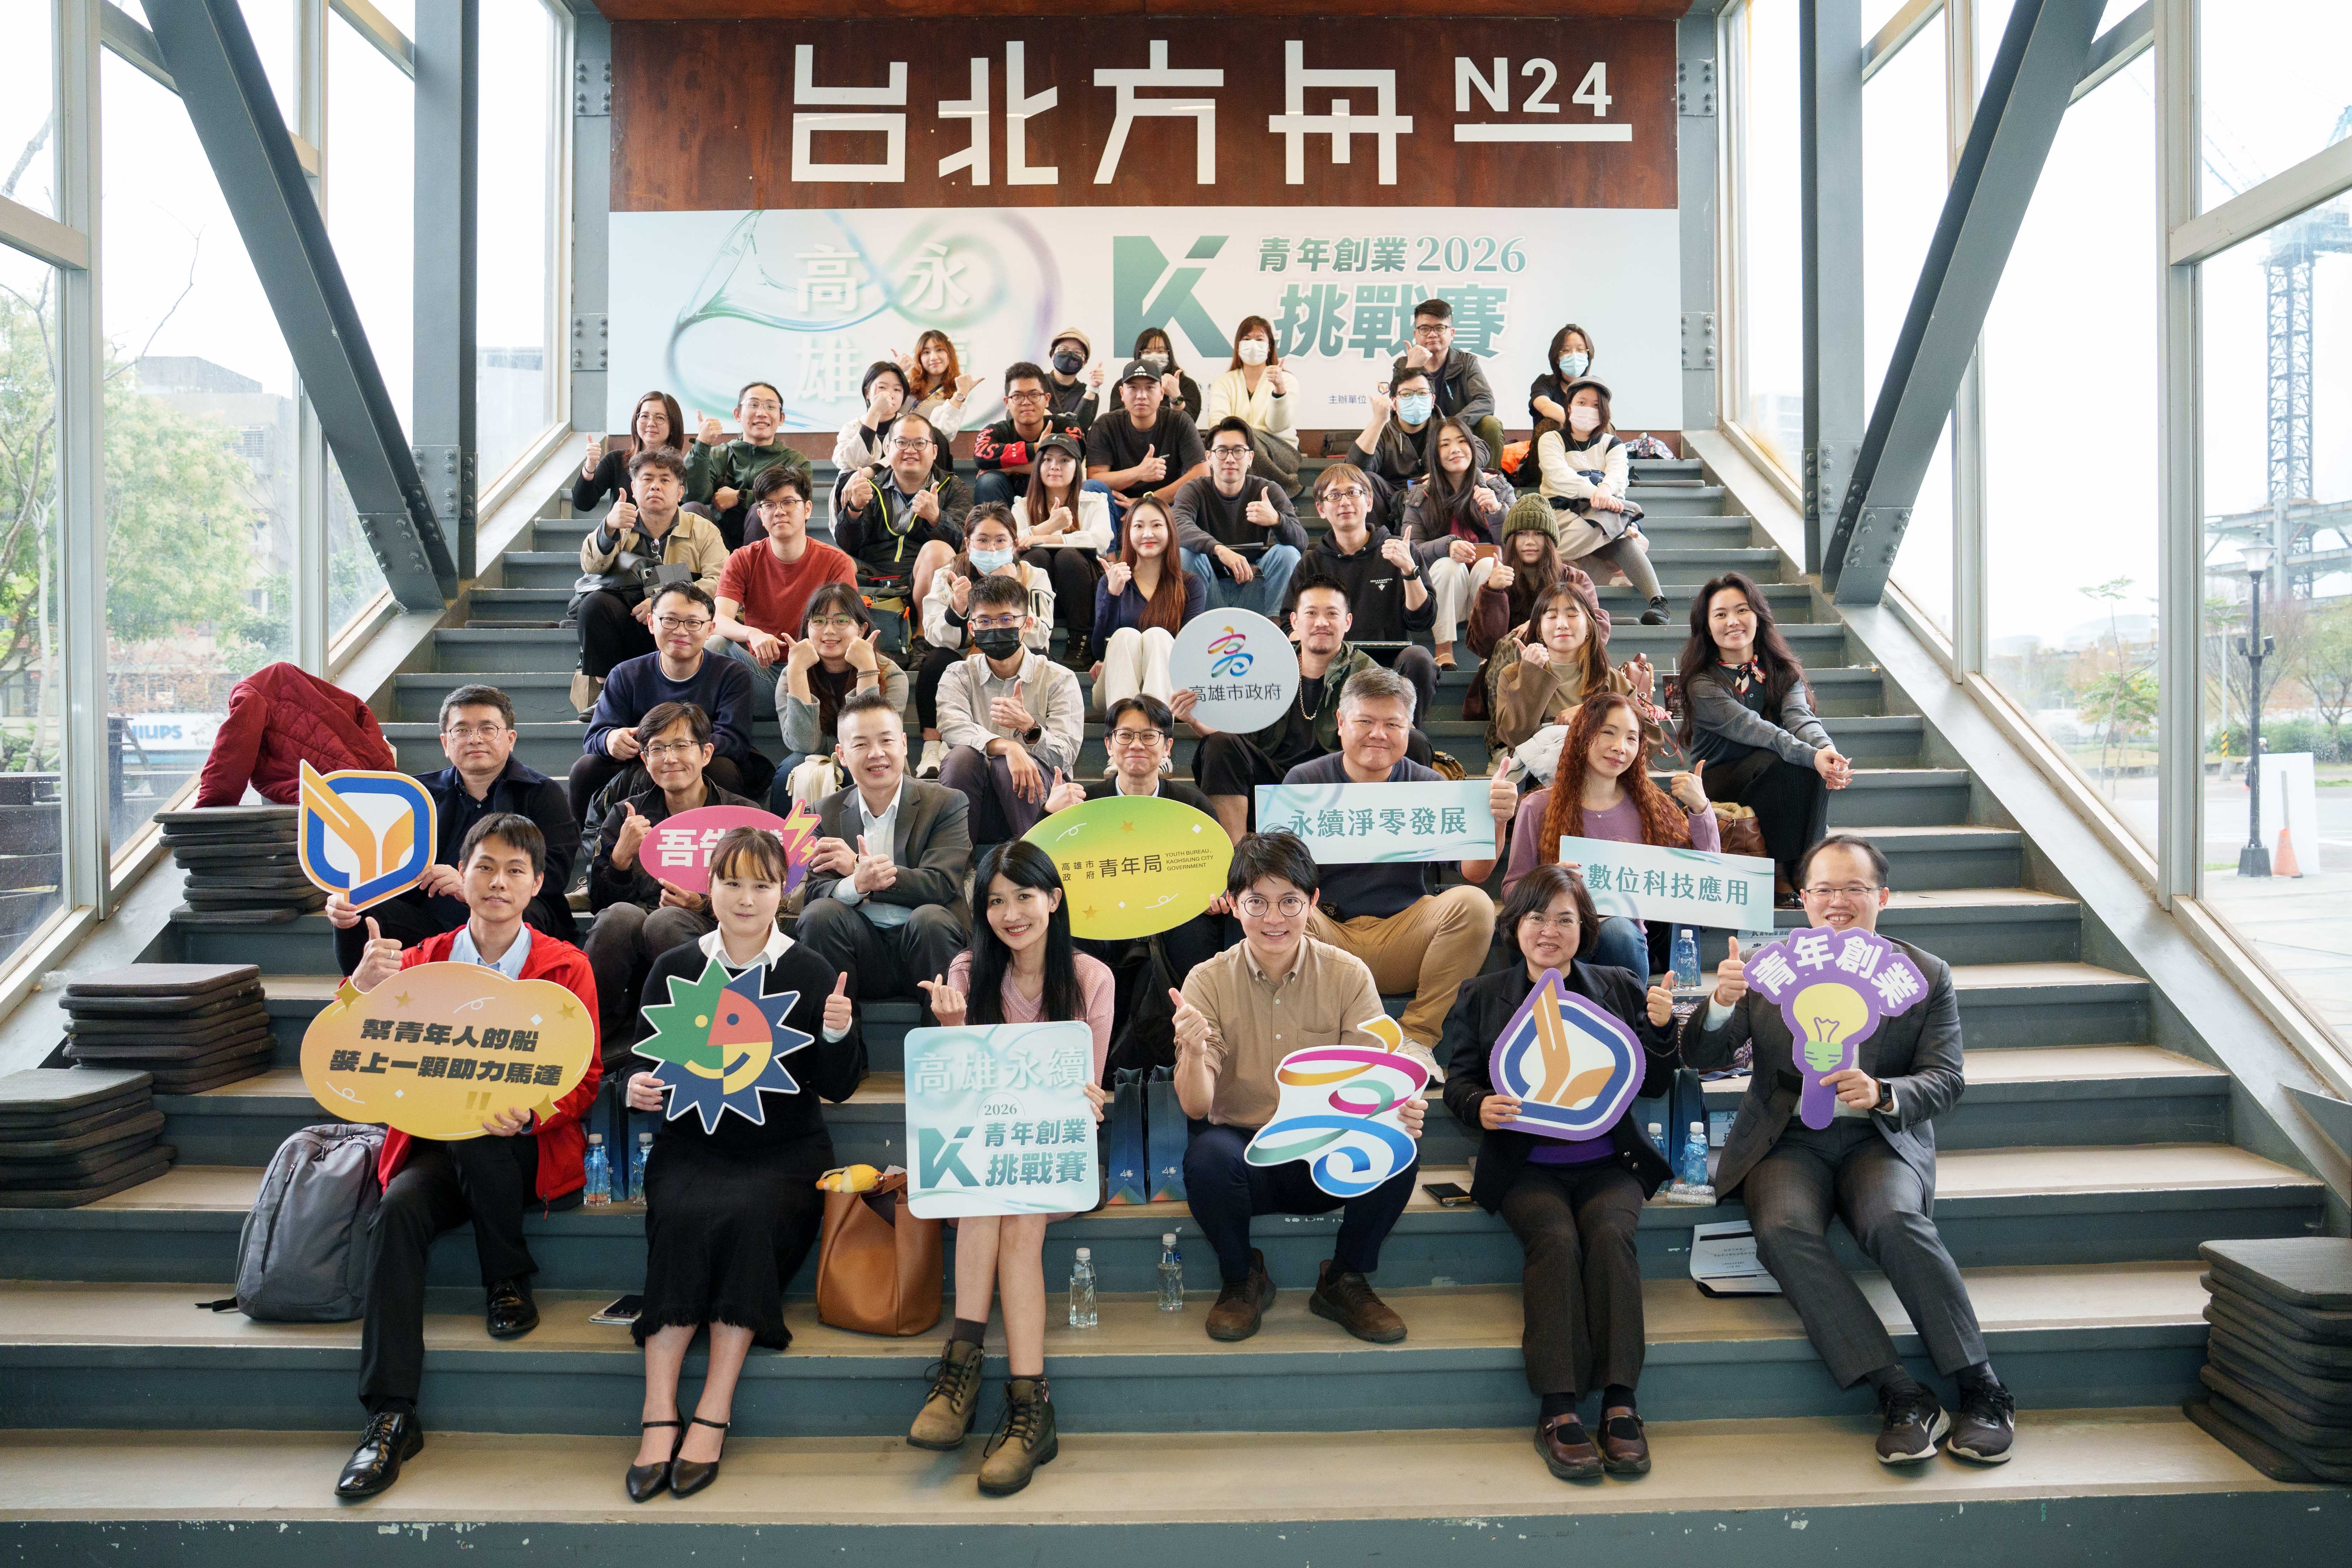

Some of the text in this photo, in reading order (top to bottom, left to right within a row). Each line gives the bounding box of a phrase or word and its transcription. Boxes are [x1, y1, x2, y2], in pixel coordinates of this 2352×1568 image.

[791, 40, 1612, 186] 台北方舟 N24
[1259, 236, 1526, 273] 青年創業 2026
[1328, 395, 1367, 404] 主辦單位
[1188, 683, 1282, 702] 高雄市政府
[1287, 807, 1467, 838] 永續淨零發展
[1061, 860, 1094, 871] 高雄市
[1098, 854, 1162, 878] 青年局
[1167, 863, 1207, 871] GOVERNMENT
[1587, 863, 1748, 906] 數位科技應用
[1751, 934, 1920, 1008] 青年創業
[360, 1018, 539, 1052] 幫青年人的船
[330, 1049, 563, 1086] 裝上一顆助力馬達
[912, 1045, 1088, 1094] 高雄永續
[984, 1103, 1017, 1116] 2026
[984, 1118, 1087, 1147] 青年創業
[985, 1150, 1088, 1187] 挑戰賽
